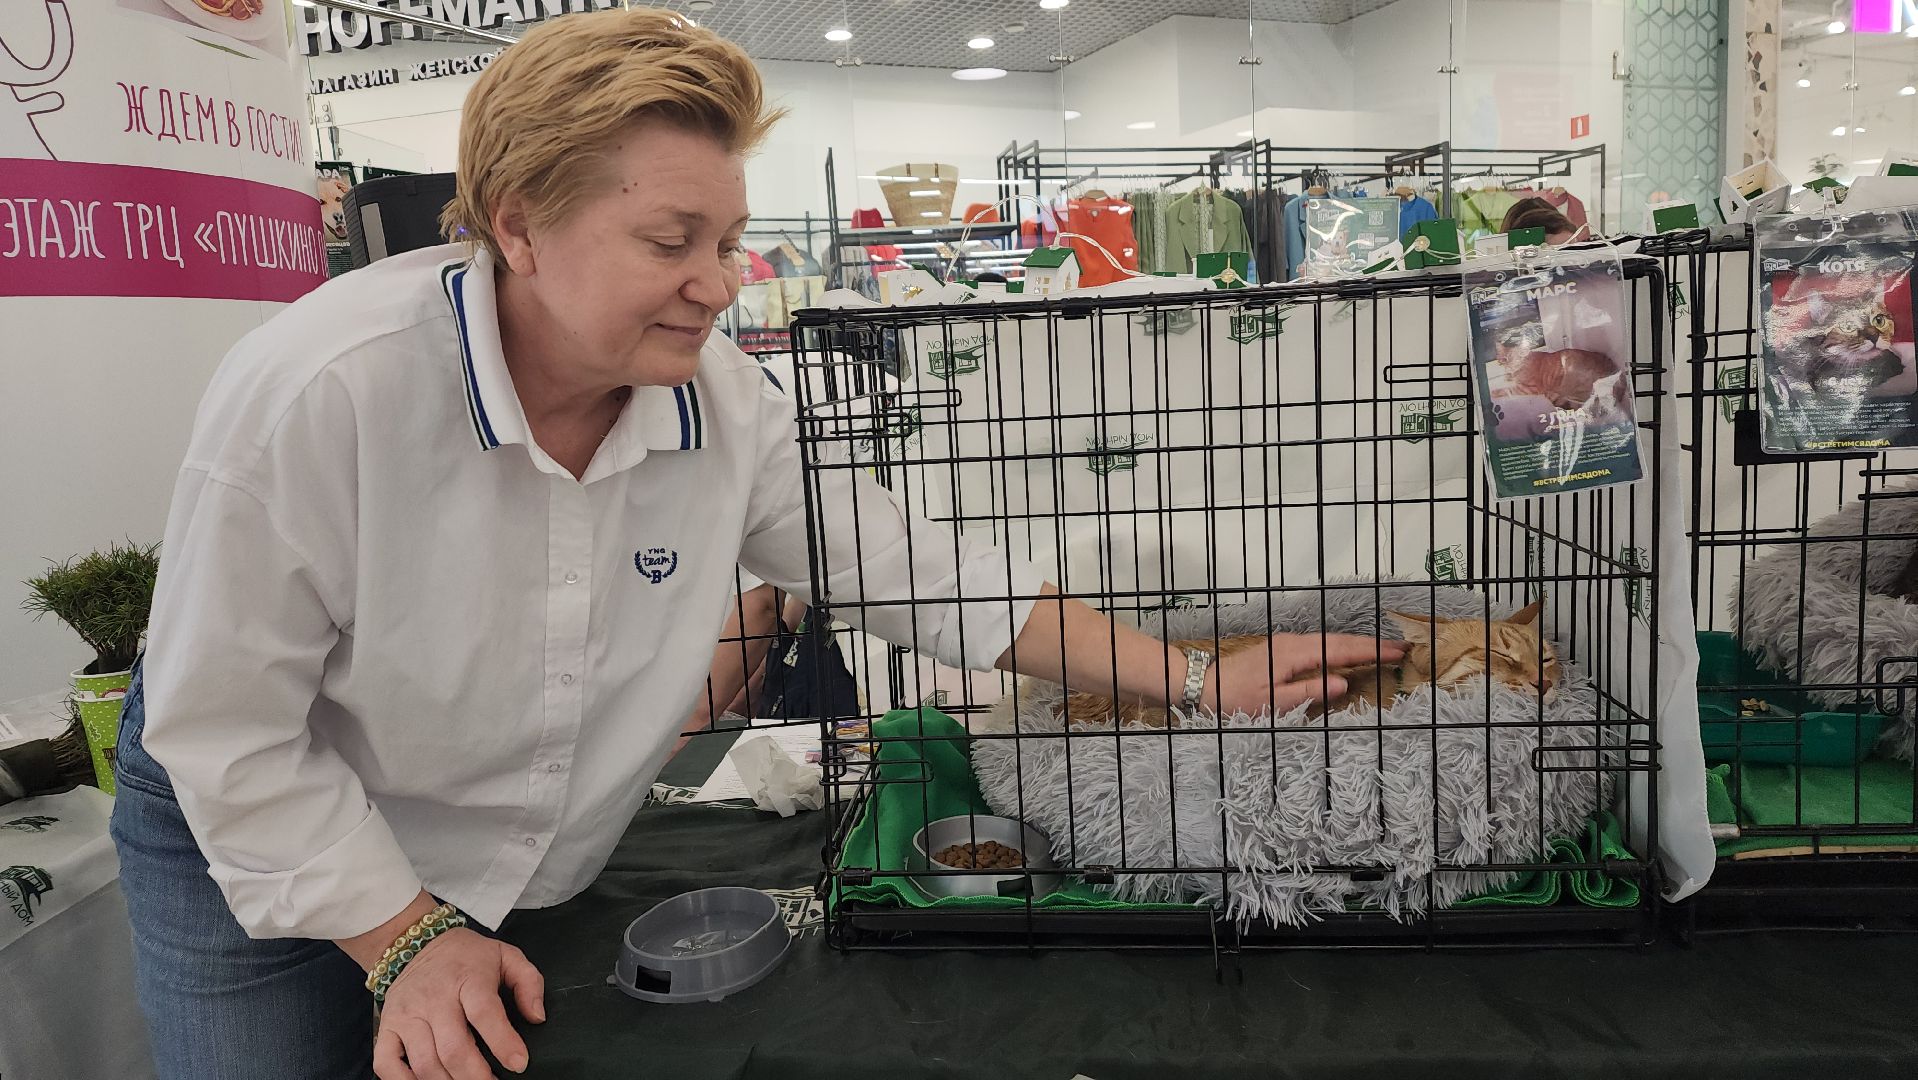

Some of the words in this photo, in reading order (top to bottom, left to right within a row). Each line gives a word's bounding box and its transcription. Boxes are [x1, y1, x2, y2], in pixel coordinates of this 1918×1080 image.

[308, 67, 398, 95] МАГАЗИН
[117, 82, 218, 144] ЖДЕМ
[225, 101, 241, 147] В
[4, 198, 106, 259] ЭТАЖ
[113, 202, 184, 268] ТРЦ
[194, 211, 319, 275] «ПУШКИНО
[1819, 257, 1867, 274] КОТЯ
[1526, 281, 1577, 301] МАРС
[642, 554, 671, 566] team
[11, 903, 35, 928] ДОМ
